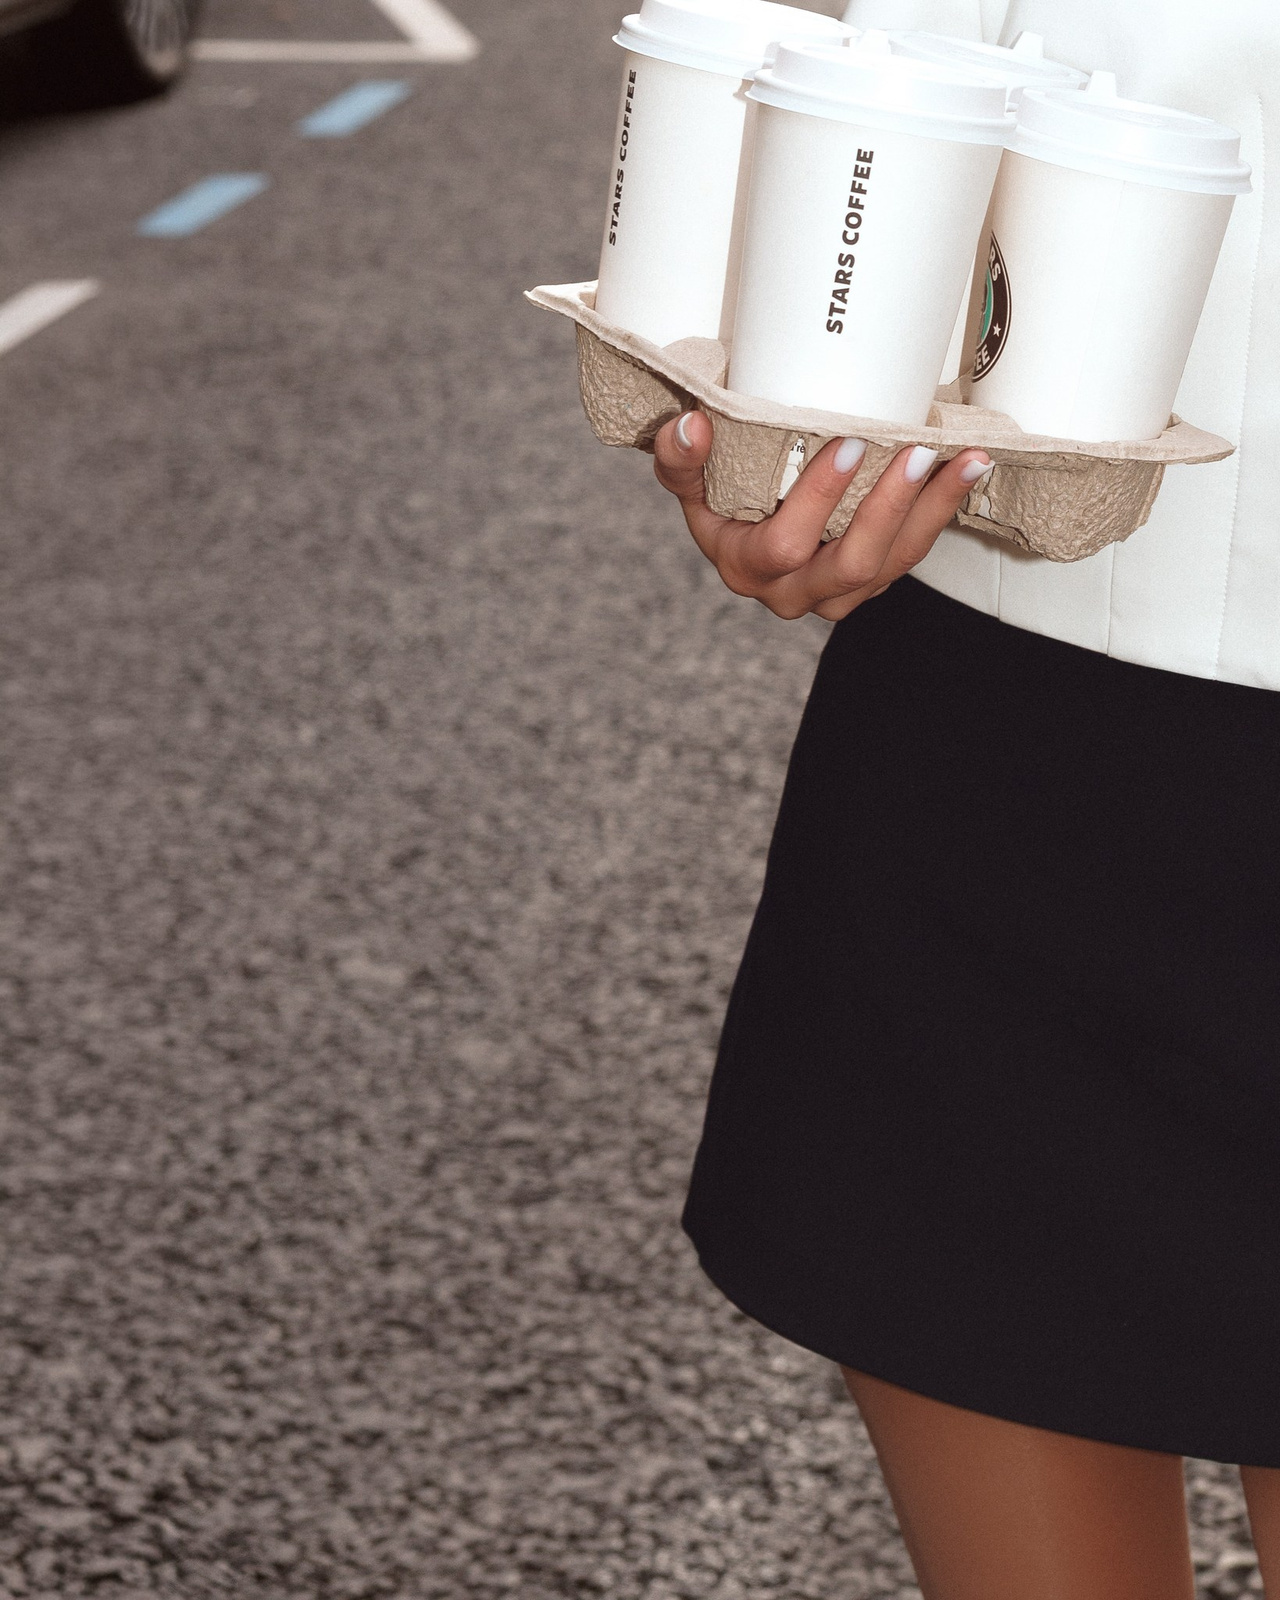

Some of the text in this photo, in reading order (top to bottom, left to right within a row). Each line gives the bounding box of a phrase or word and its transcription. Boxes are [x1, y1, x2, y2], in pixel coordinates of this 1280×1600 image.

[609, 69, 637, 246] STARS COFFEE
[826, 149, 874, 335] STARS COFFEE
